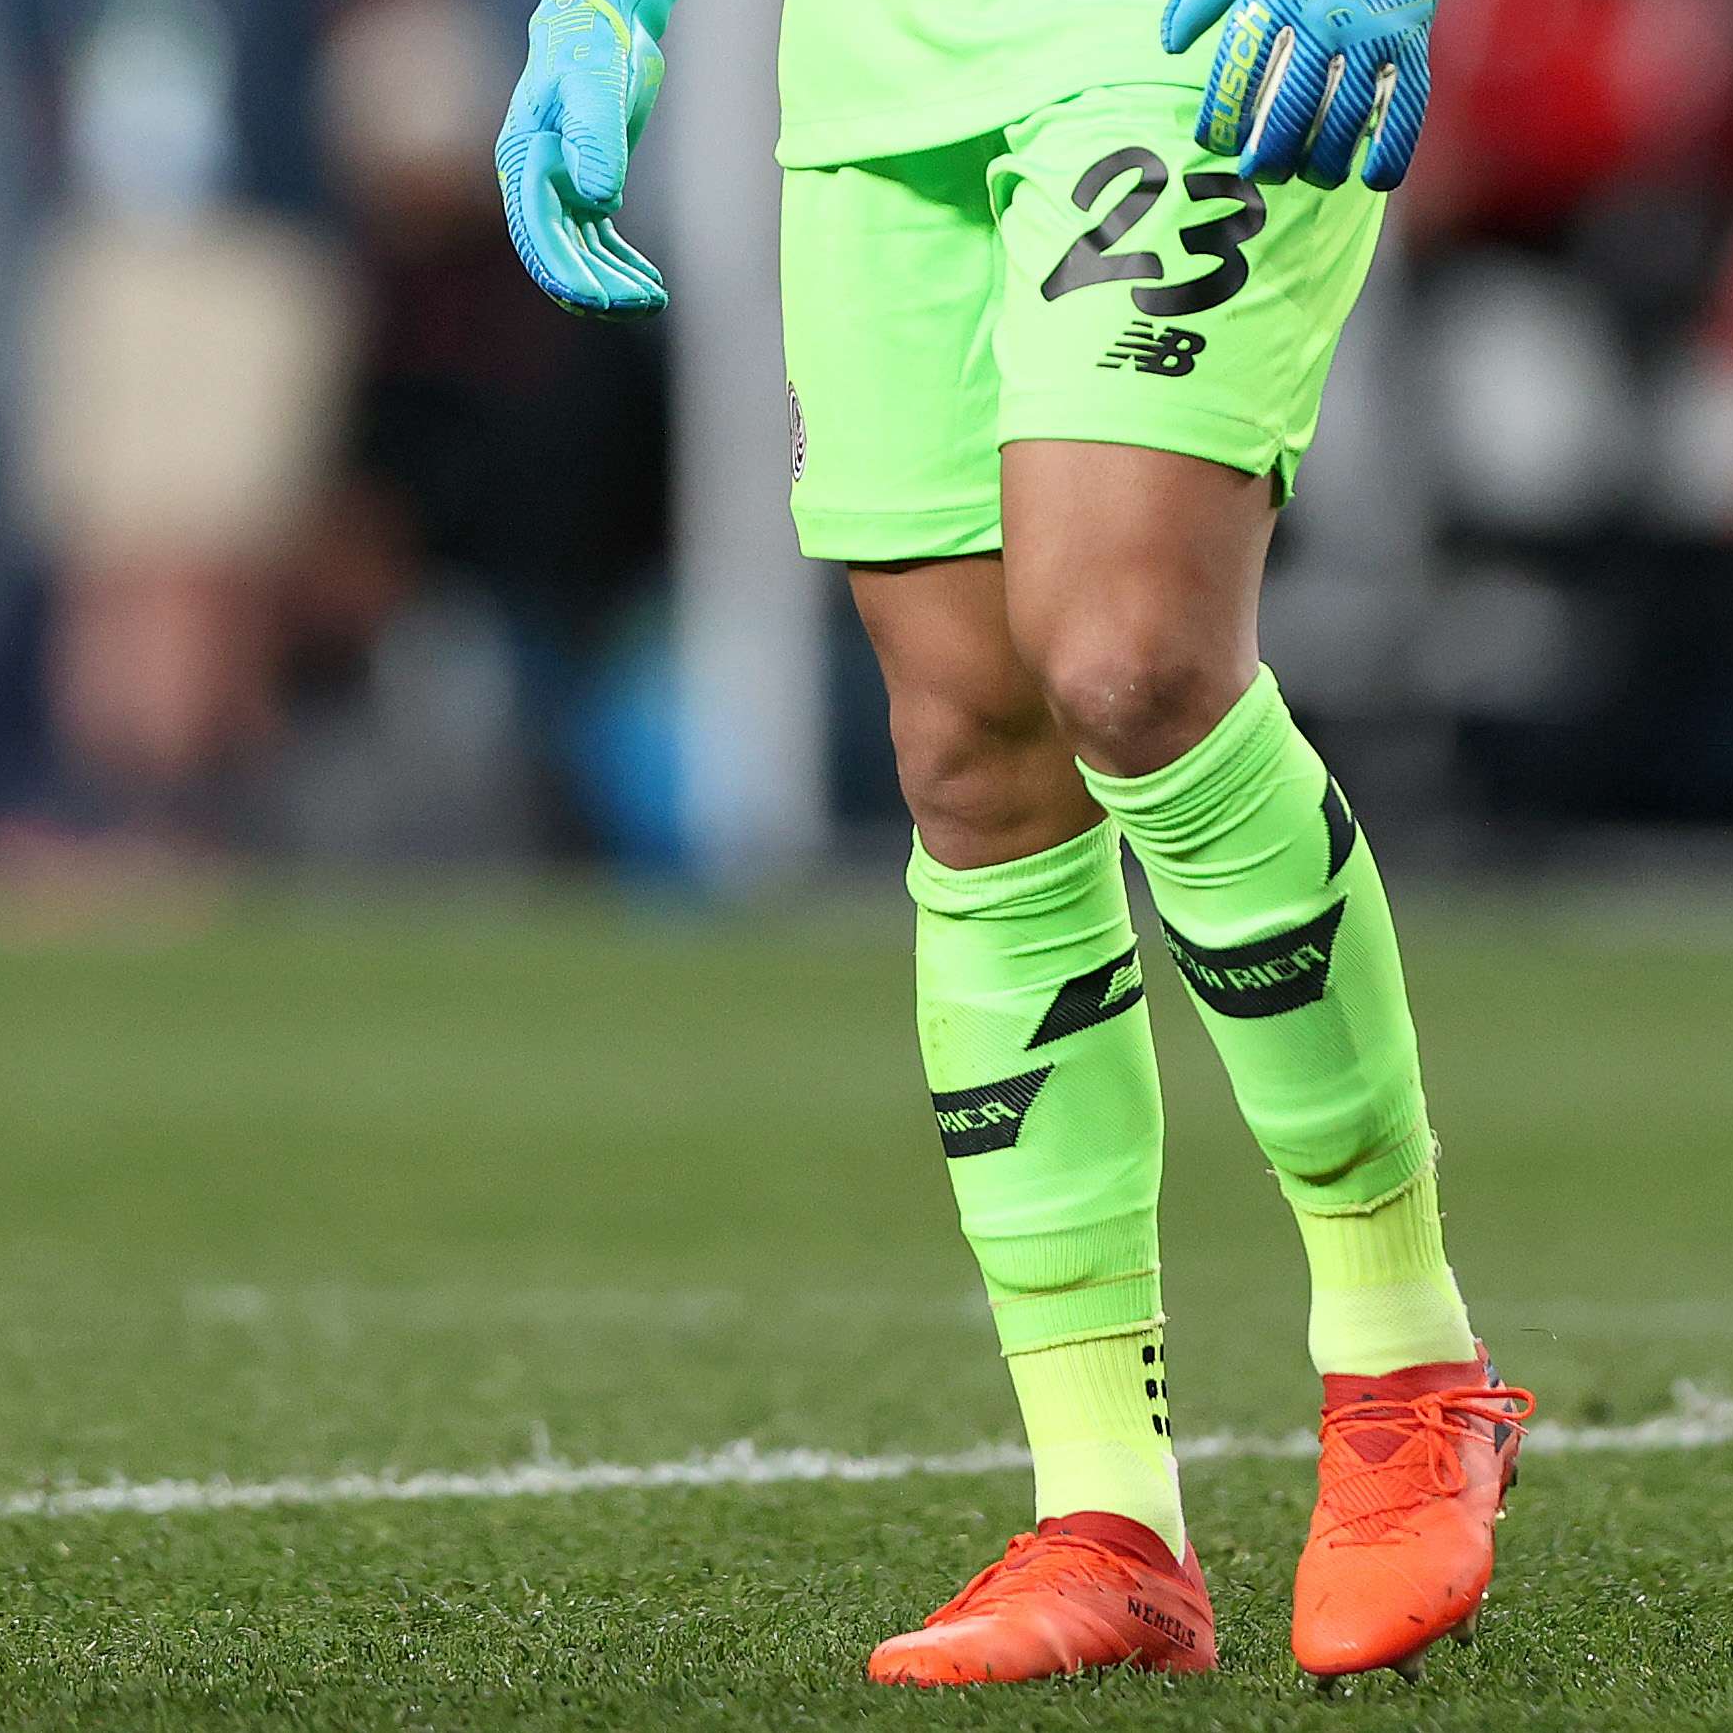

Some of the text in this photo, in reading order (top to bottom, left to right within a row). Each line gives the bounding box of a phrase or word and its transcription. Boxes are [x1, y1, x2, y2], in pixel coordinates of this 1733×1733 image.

[1208, 0, 1271, 151] eusch
[1040, 146, 1267, 317] 23
[1224, 942, 1327, 992] RICA
[1127, 1594, 1197, 1651] NEMESIS
